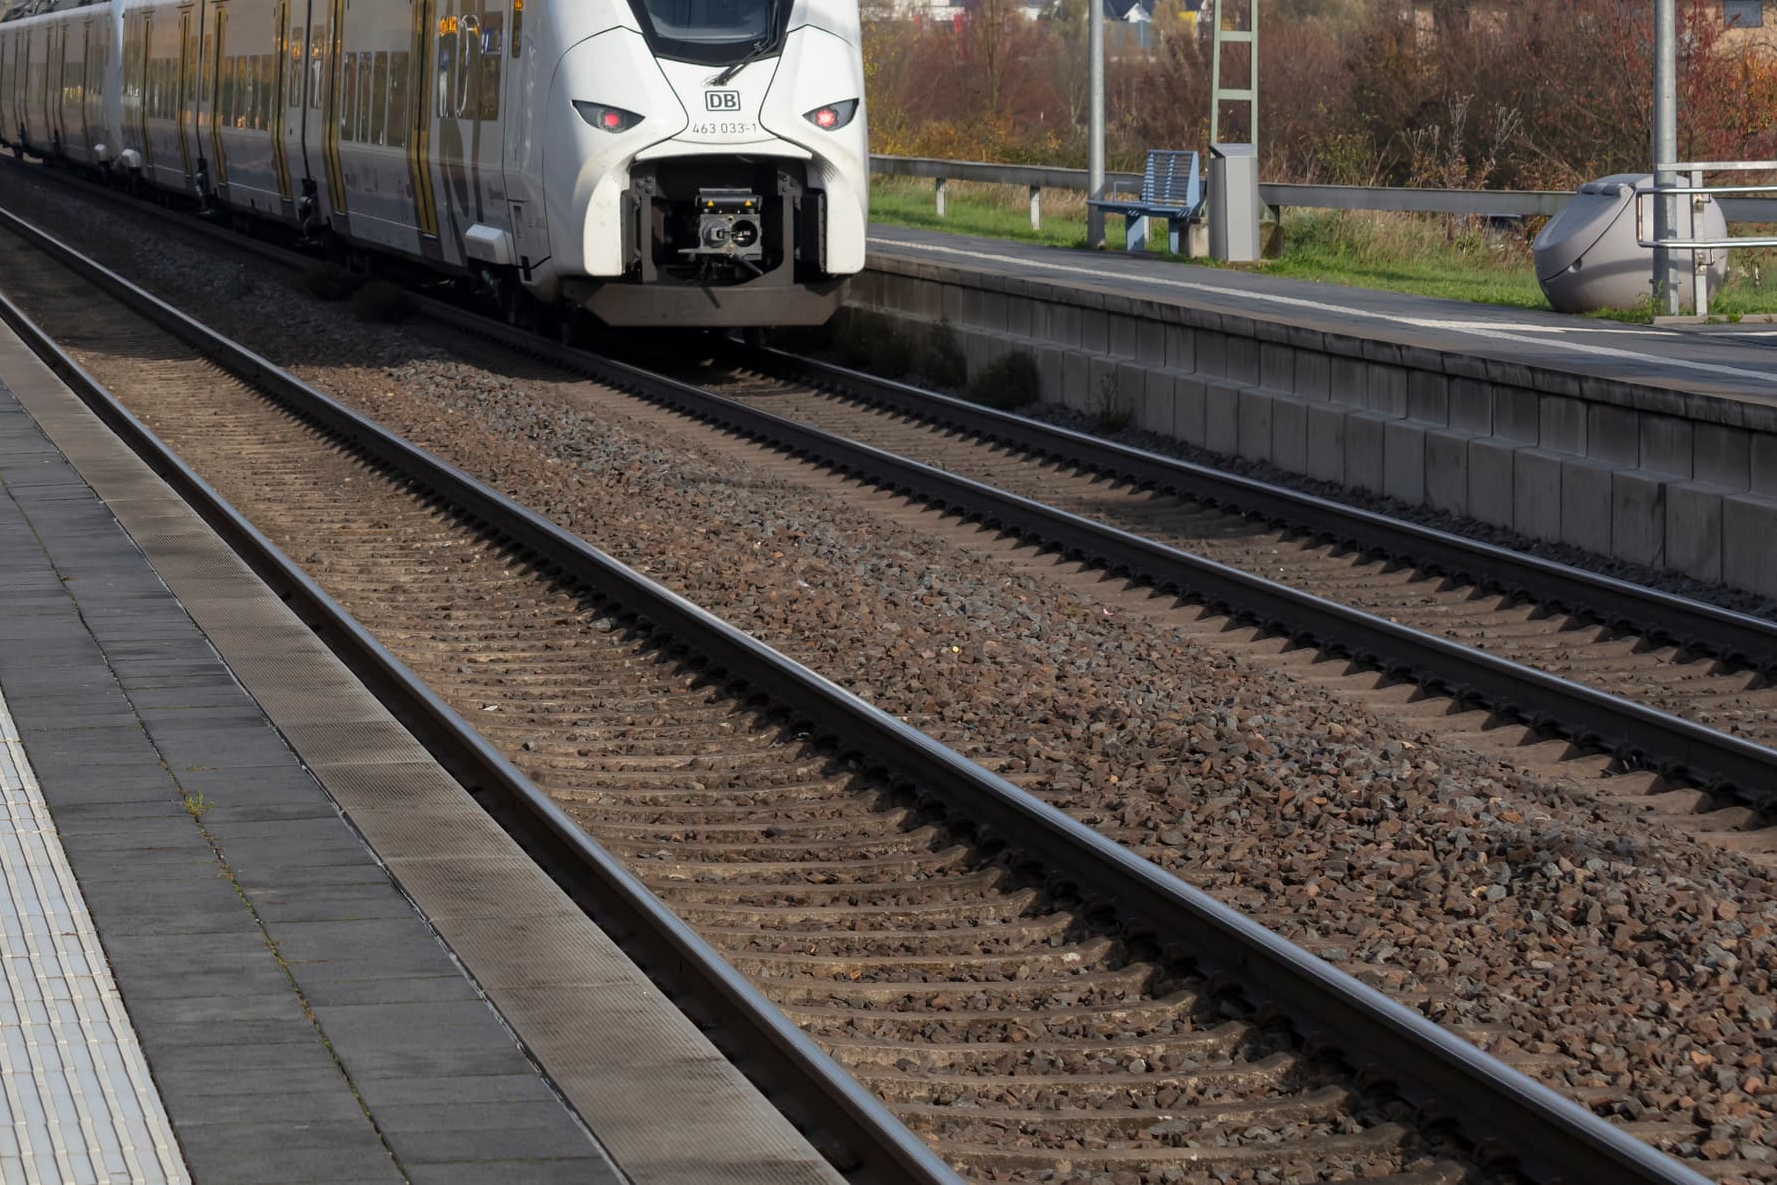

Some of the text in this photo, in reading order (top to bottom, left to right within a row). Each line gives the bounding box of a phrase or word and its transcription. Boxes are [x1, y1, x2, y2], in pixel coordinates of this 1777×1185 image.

[708, 93, 738, 109] DB
[692, 123, 757, 134] 463 033-1
